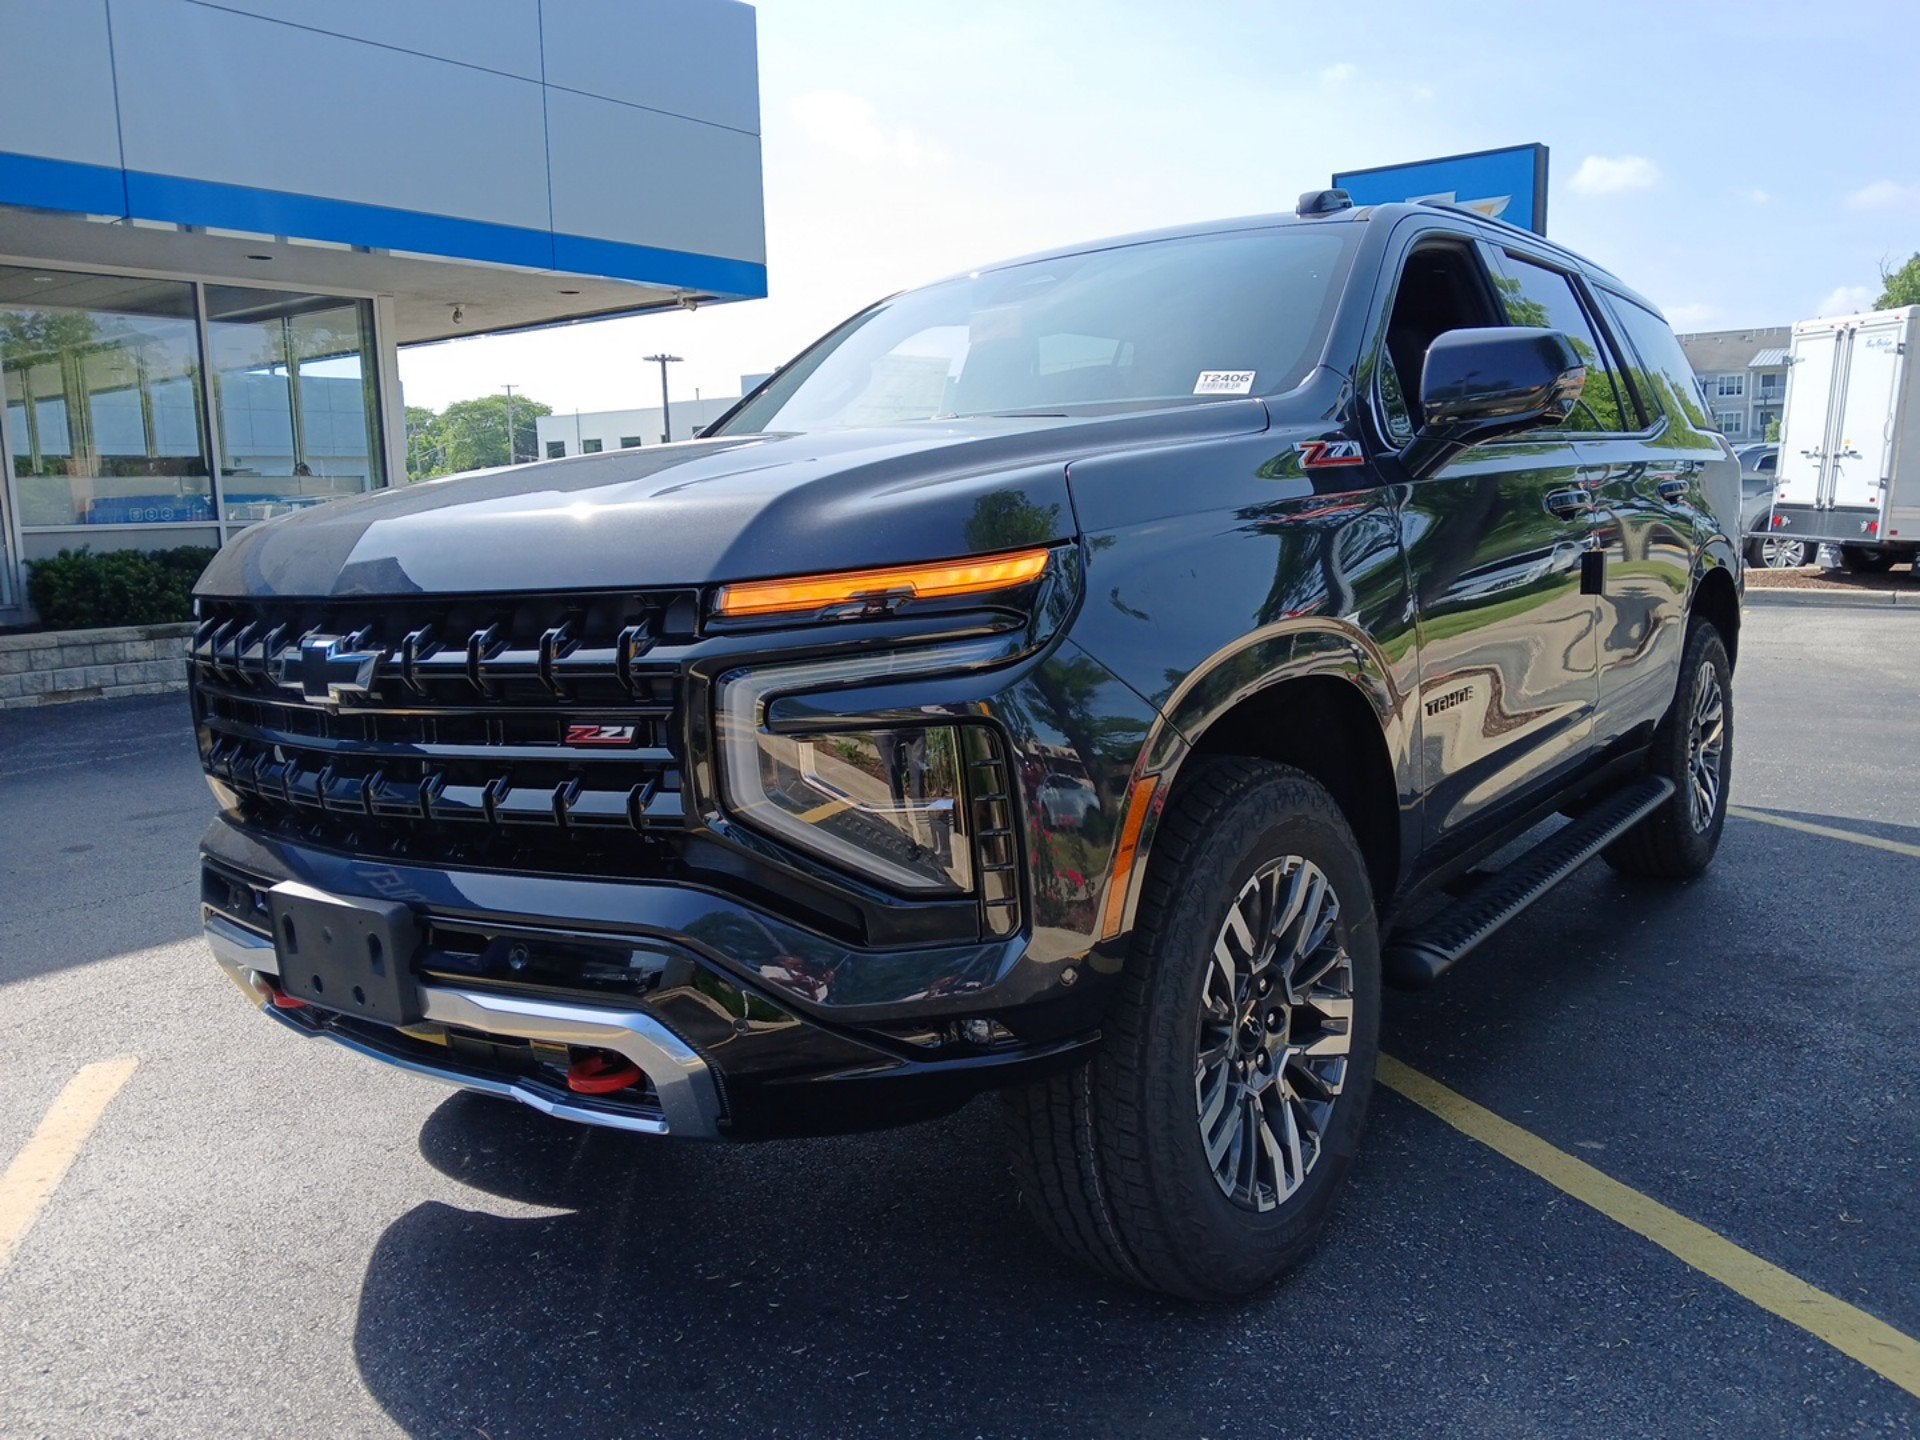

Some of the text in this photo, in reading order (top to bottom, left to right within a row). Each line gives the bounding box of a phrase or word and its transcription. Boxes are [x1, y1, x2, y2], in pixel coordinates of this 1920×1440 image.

[1202, 374, 1250, 382] T2406
[1292, 440, 1364, 469] Z71
[565, 725, 635, 743] Z71
